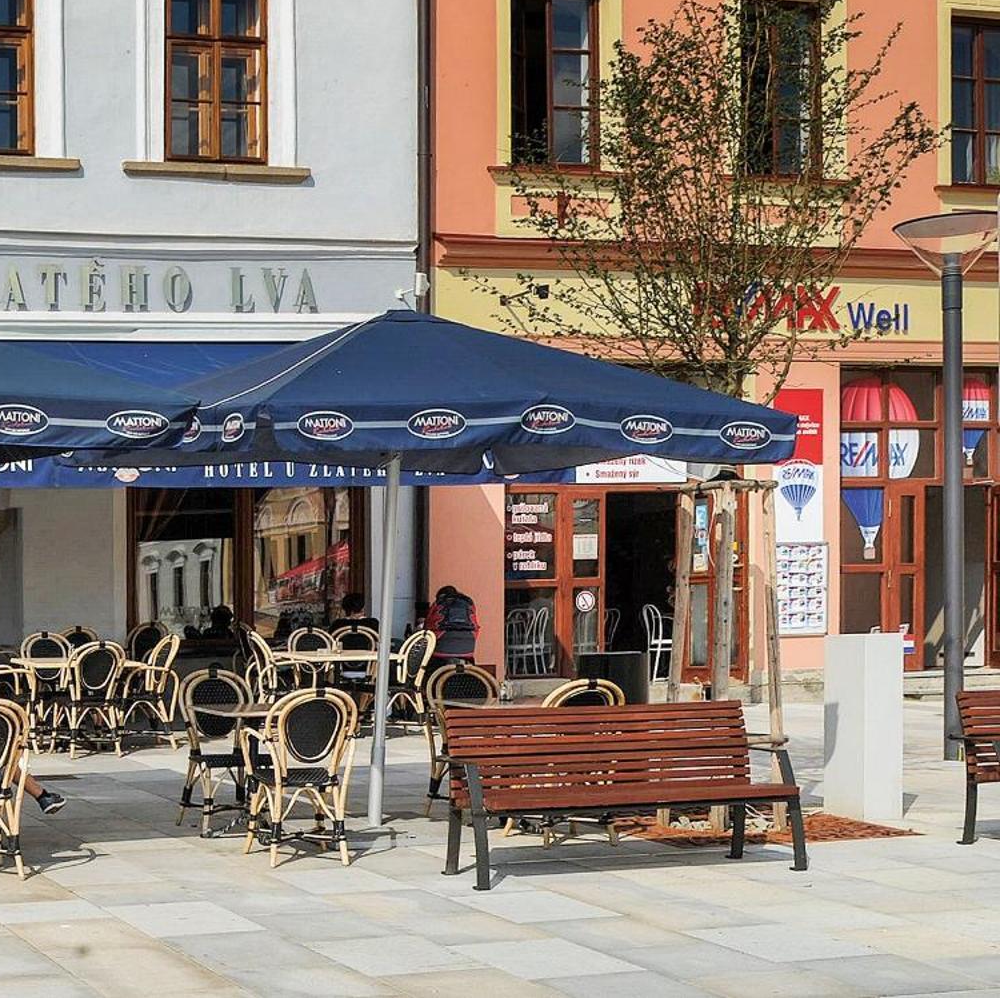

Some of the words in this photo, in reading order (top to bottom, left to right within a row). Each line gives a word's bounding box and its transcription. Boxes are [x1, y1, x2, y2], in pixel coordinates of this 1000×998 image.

[230, 266, 321, 313] LVA
[847, 302, 909, 333] Well
[113, 416, 162, 427] MATTONI
[304, 417, 346, 429] MATTONI
[414, 415, 458, 426] MATTONI
[526, 411, 568, 423] MATTONI
[625, 421, 667, 433] MATTONI
[726, 427, 766, 440] MATTONI
[204, 461, 273, 478] HOTEL
[286, 461, 295, 477] U
